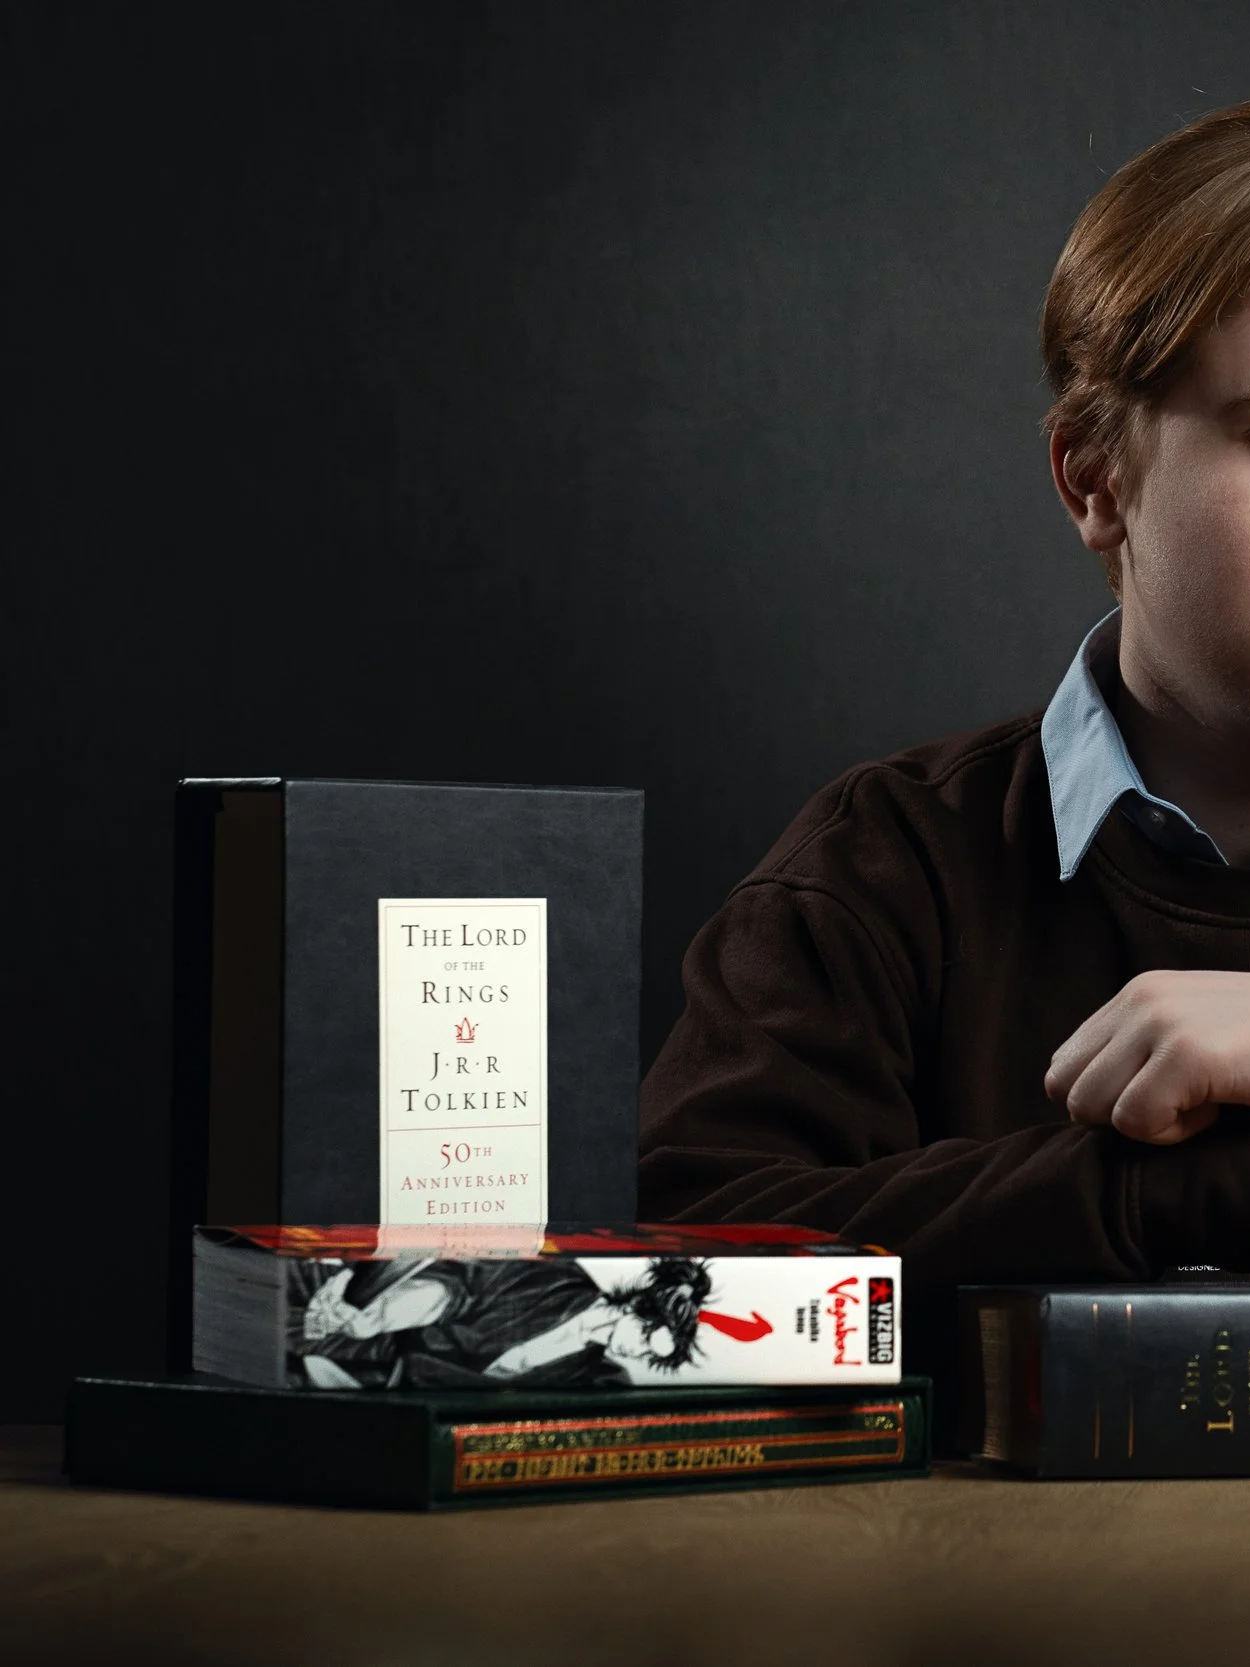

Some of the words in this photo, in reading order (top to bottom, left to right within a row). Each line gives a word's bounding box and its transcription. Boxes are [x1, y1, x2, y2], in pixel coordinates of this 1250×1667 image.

[401, 924, 453, 947] THE
[462, 924, 527, 947] LORD
[444, 961, 459, 971] OF
[462, 961, 485, 971] THE
[421, 981, 510, 1004] RINGS
[401, 1089, 529, 1112] TOLKIEN
[440, 1142, 493, 1169] 50TH
[401, 1173, 529, 1191] ANNIVERSARY
[426, 1200, 506, 1215] EDITION
[826, 1275, 862, 1366] Vagabond
[876, 1303, 893, 1362] VIZBIG
